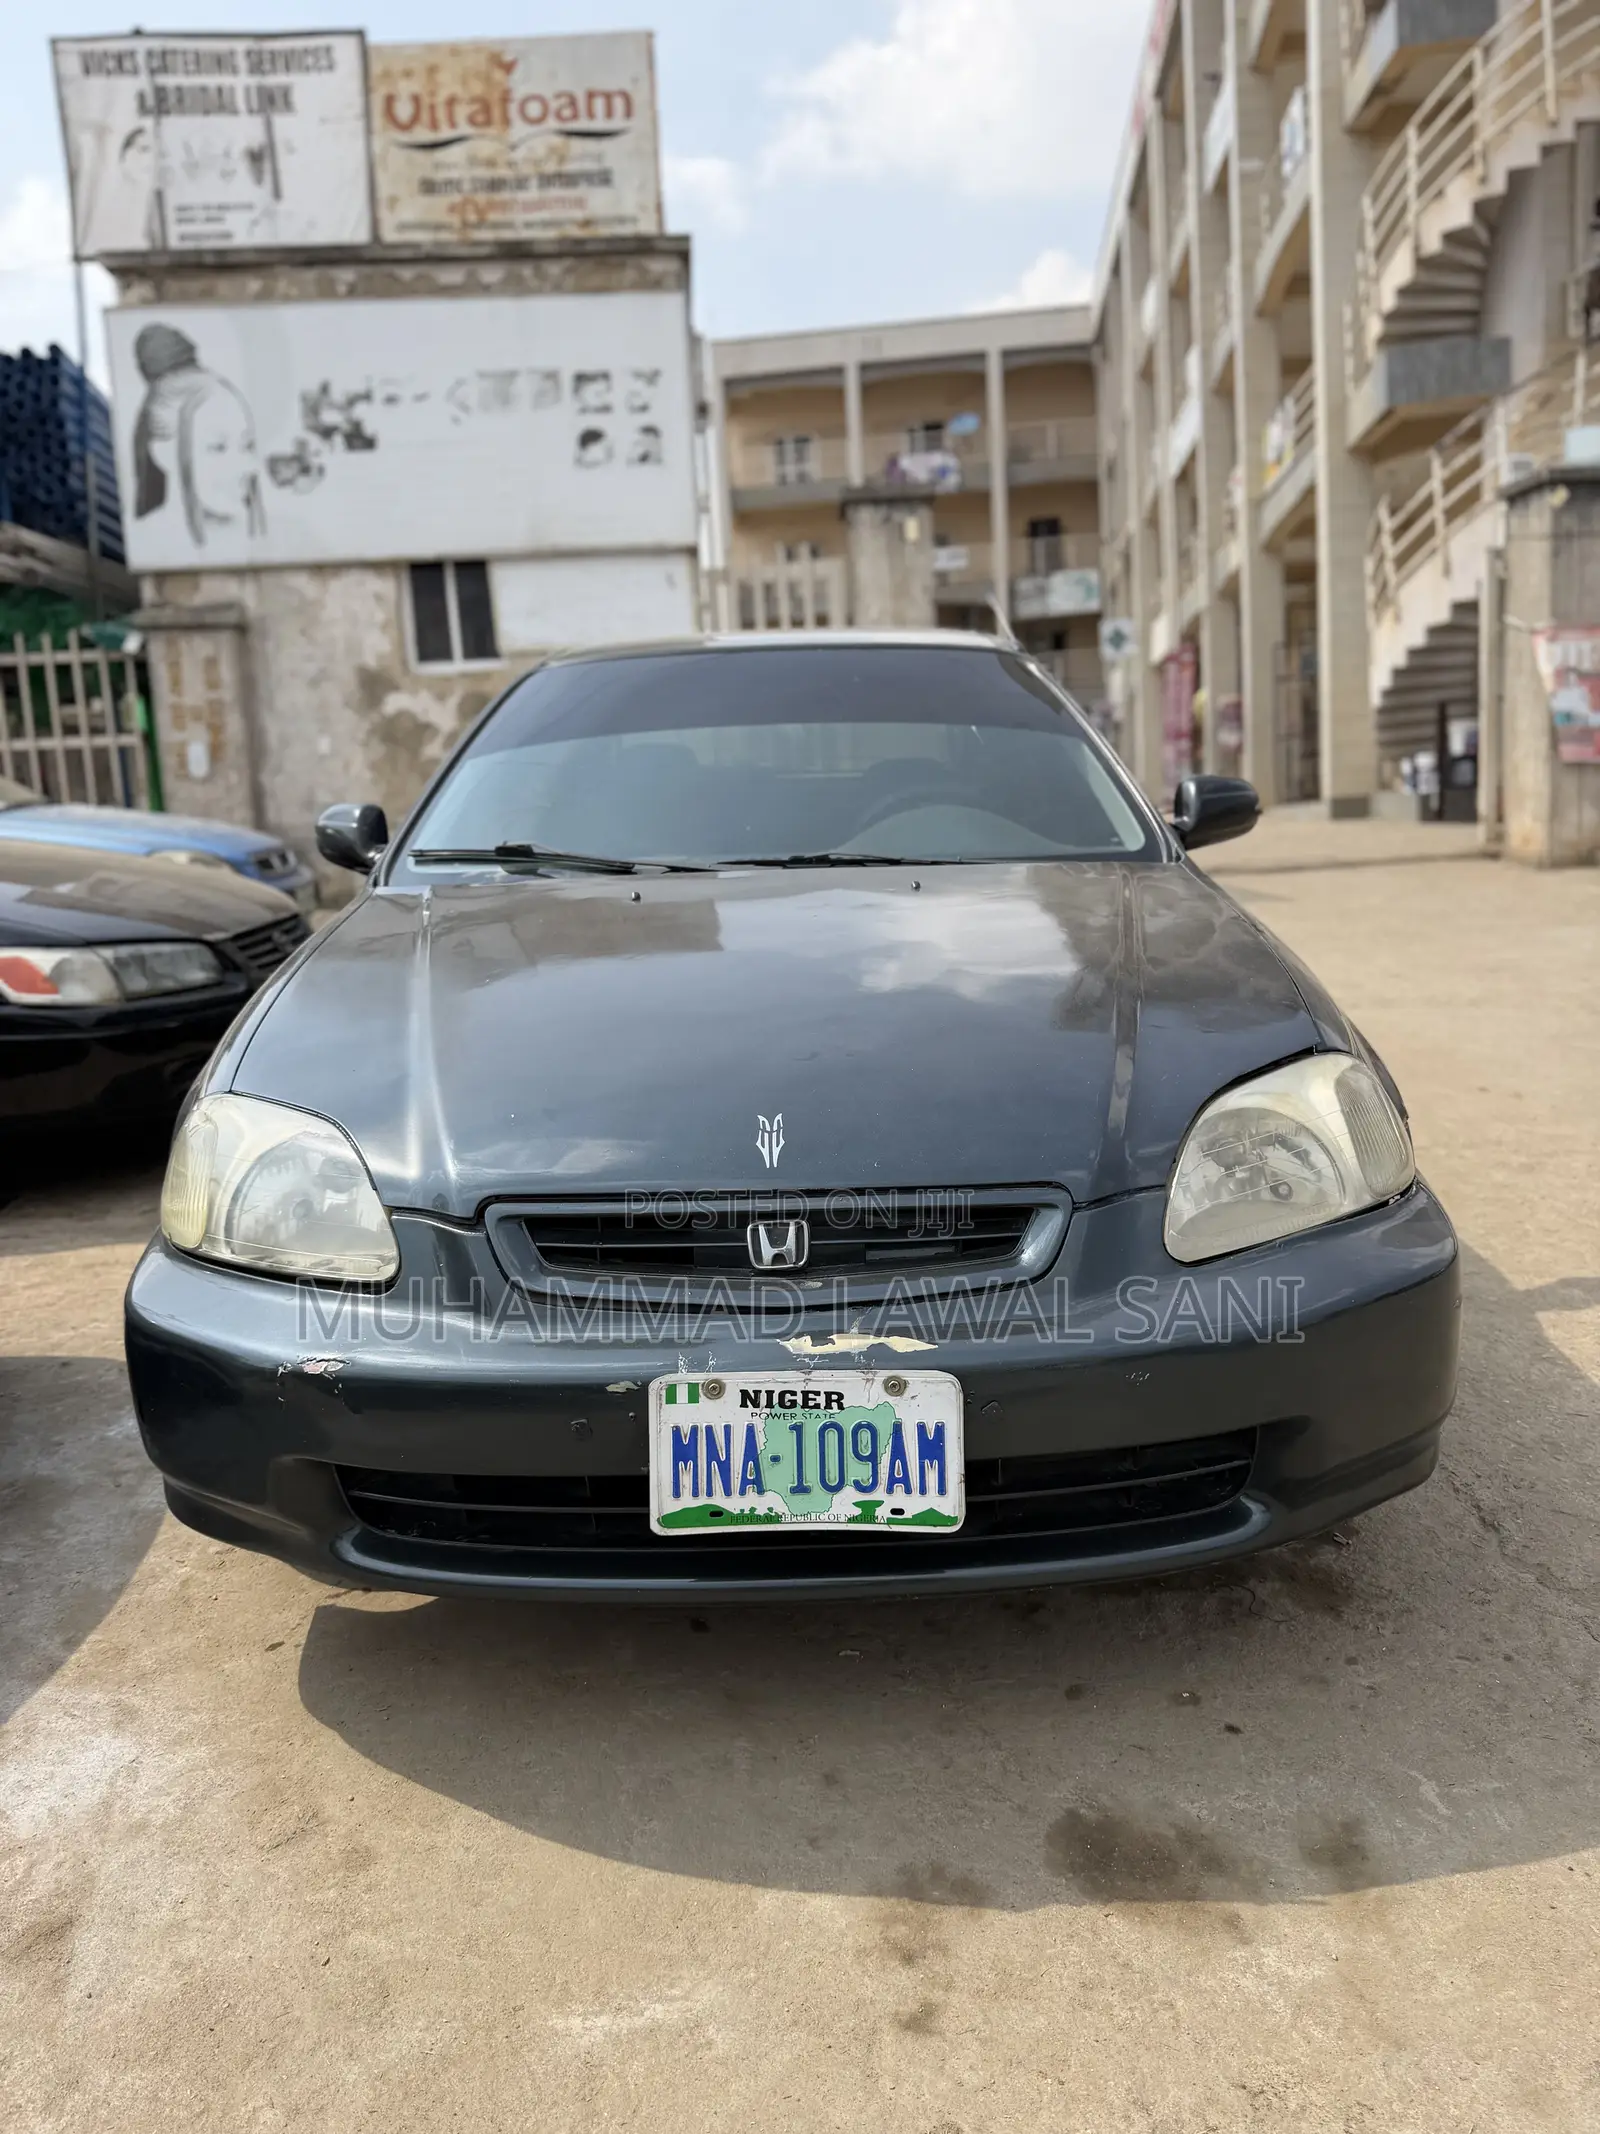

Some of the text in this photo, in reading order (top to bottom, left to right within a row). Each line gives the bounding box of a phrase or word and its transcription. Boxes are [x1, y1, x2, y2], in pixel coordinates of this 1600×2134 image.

[79, 44, 335, 77] VICKS CATERING SERVICES
[245, 83, 296, 116] LINK
[739, 1389, 845, 1411] NIGER
[750, 1412, 836, 1421] POWER STATE
[730, 1512, 887, 1524] FEDERAL REPUBLIC OF NIGERIA
